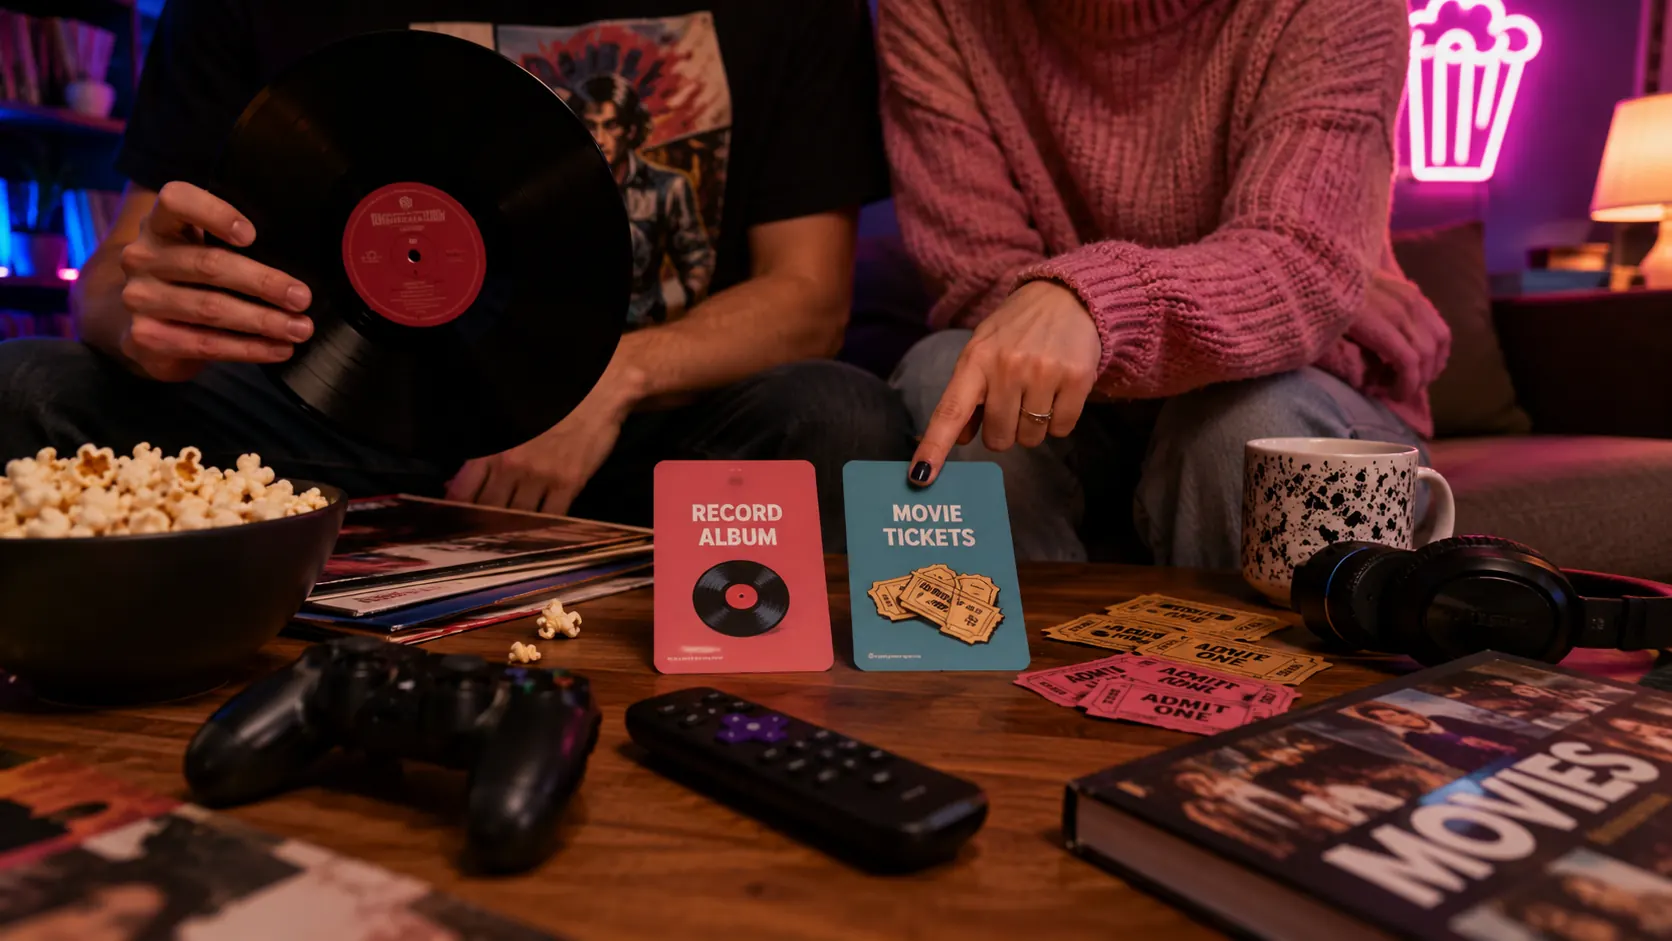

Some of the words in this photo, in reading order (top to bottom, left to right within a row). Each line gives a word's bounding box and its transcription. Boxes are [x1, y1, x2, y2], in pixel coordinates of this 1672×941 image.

[692, 504, 783, 522] RECORD
[892, 504, 963, 522] MOVIE
[699, 528, 777, 546] ALBUM
[883, 528, 976, 546] TICKETS
[1196, 651, 1245, 668] ONE
[1141, 693, 1230, 714] ADMIT
[1154, 705, 1213, 722] ONE
[1322, 741, 1660, 909] MOVIES
